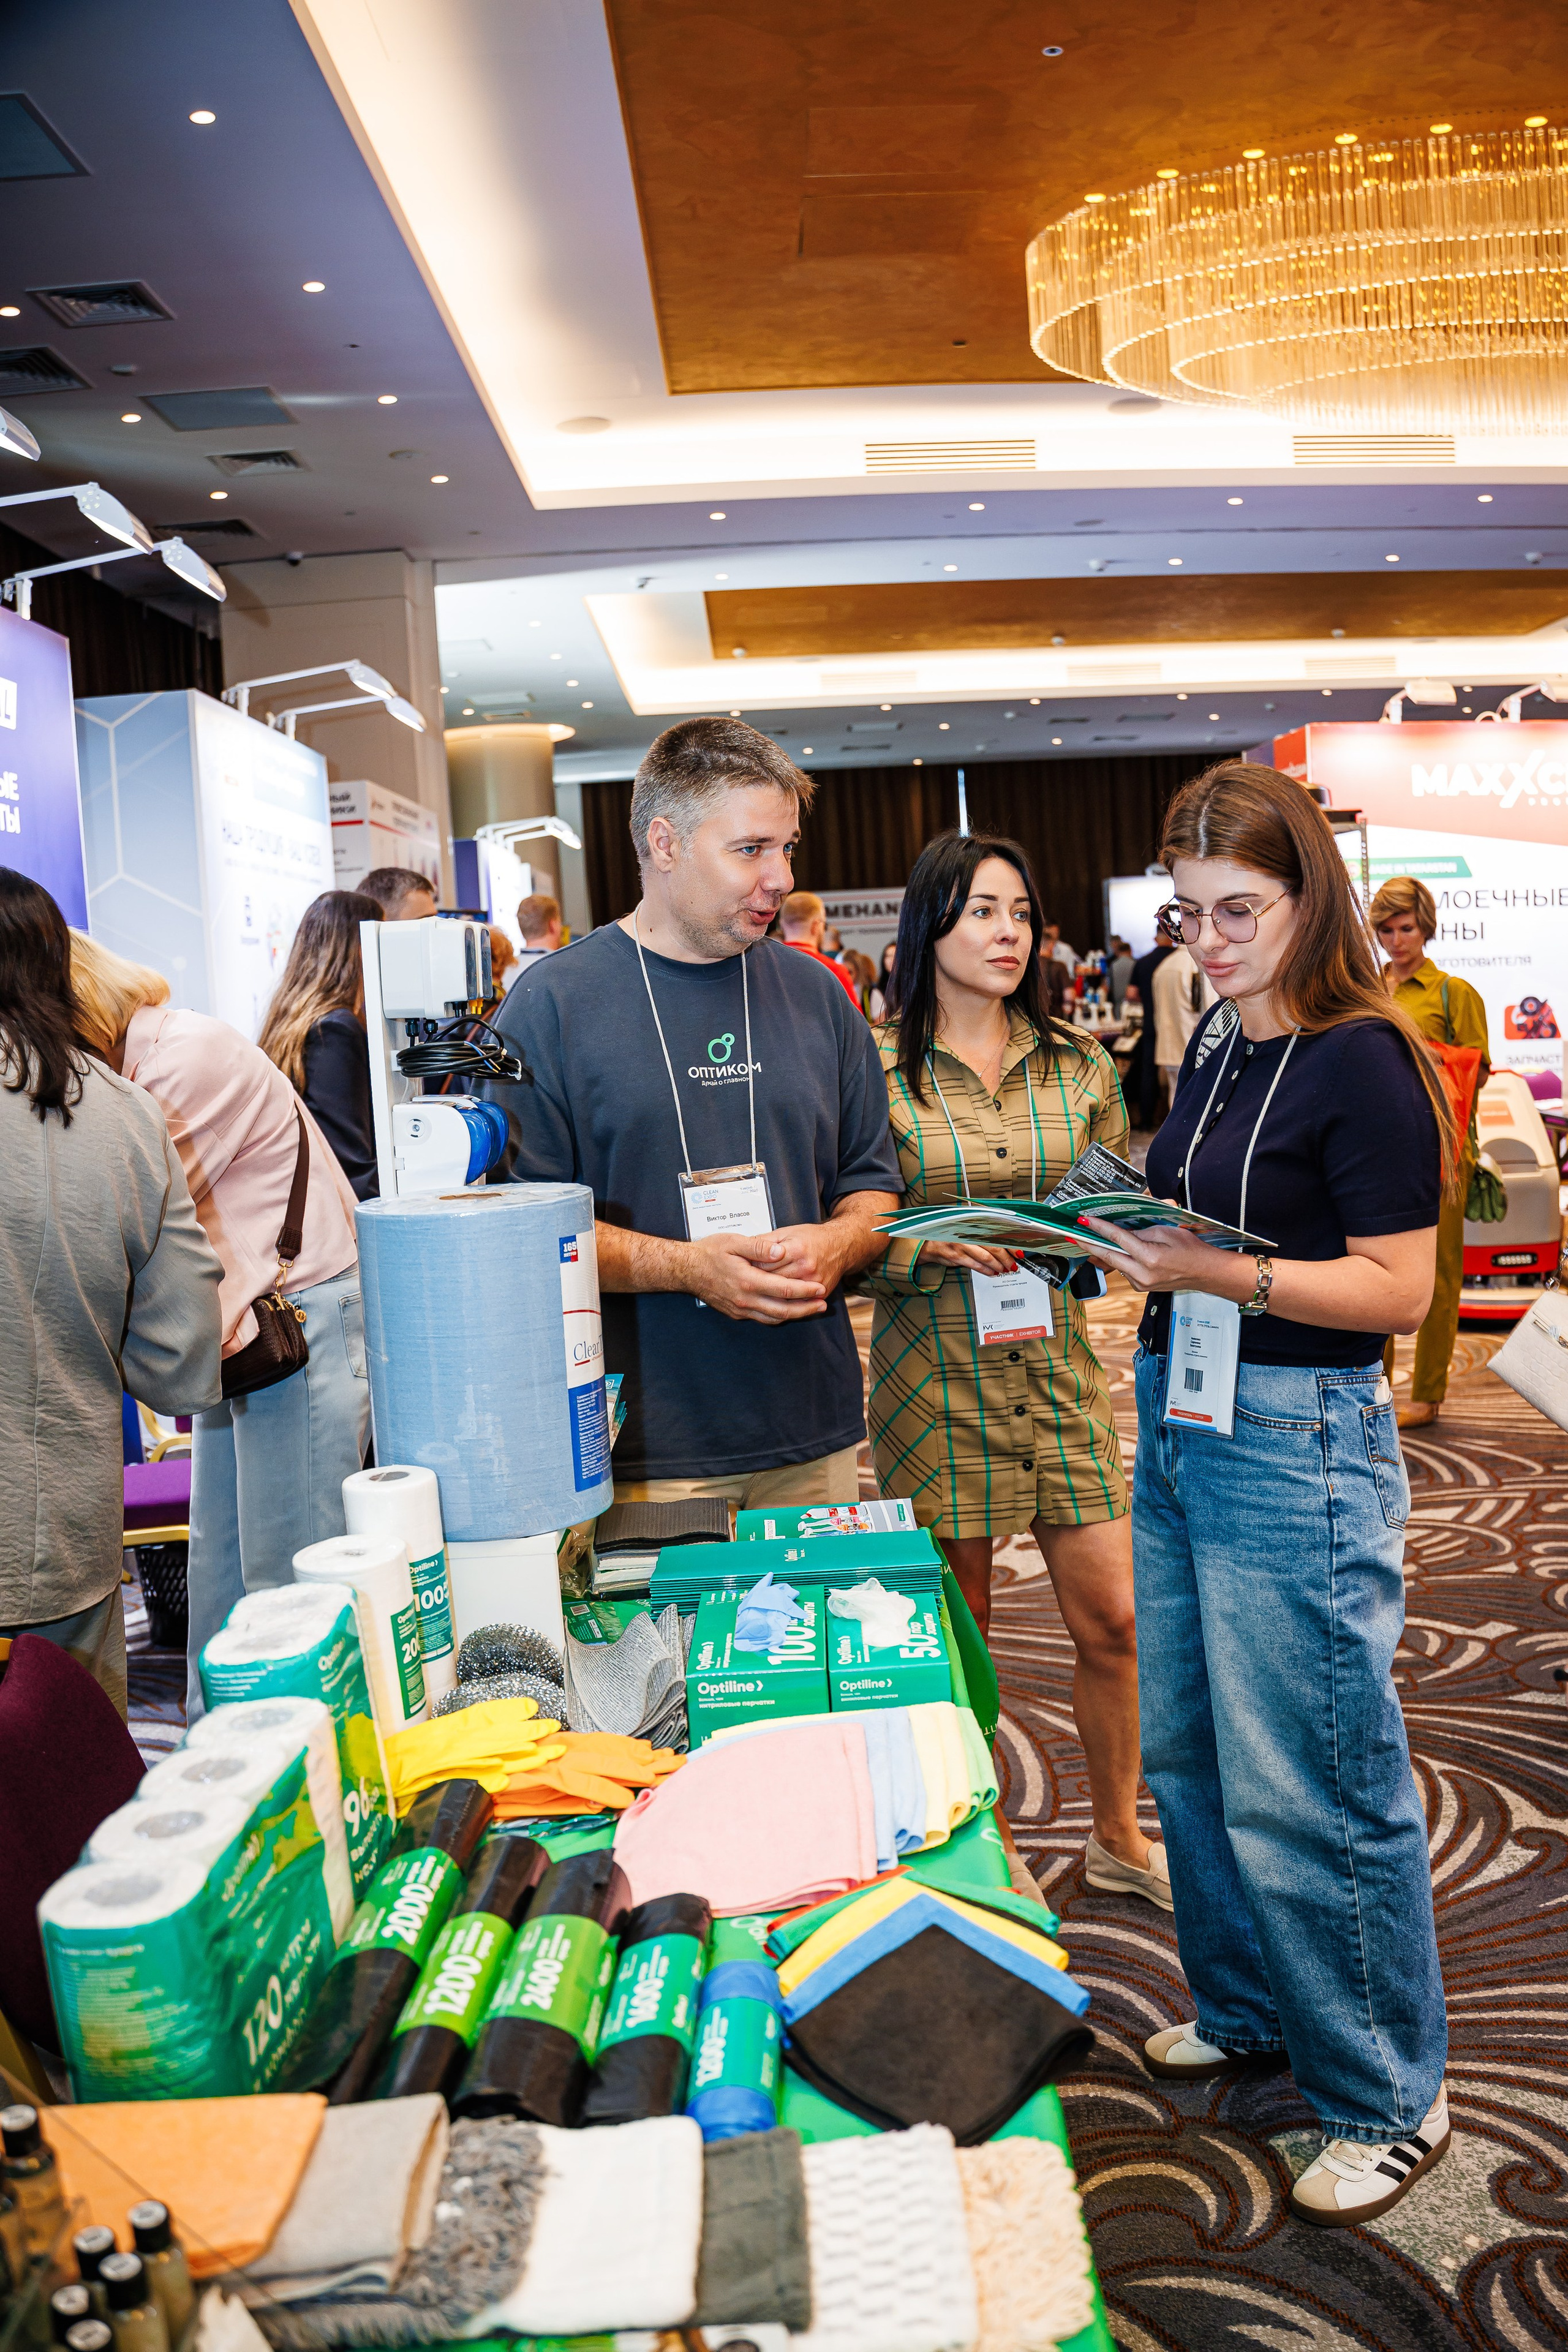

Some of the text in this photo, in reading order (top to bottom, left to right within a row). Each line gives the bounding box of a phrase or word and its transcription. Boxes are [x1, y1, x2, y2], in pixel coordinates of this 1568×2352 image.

[1411, 749, 1568, 809] MAXXC
[1436, 956, 1532, 968] ЗГОТОВИТЕЛЯ
[1506, 1055, 1562, 1066] ЗАПЧАСТ
[563, 1242, 576, 1252] 165
[923, 1613, 937, 1635] защиты
[696, 1645, 715, 1670] Optiline
[767, 1626, 816, 1665] 100
[836, 1638, 856, 1665] Optiline
[899, 1634, 941, 1658] 50
[698, 1680, 755, 1697] Optiline
[840, 1679, 886, 1692] Optiline
[381, 1883, 435, 1946] 2000
[423, 1954, 483, 2016] 1200
[520, 1958, 564, 2011] 2400
[243, 1975, 283, 2067] 120
